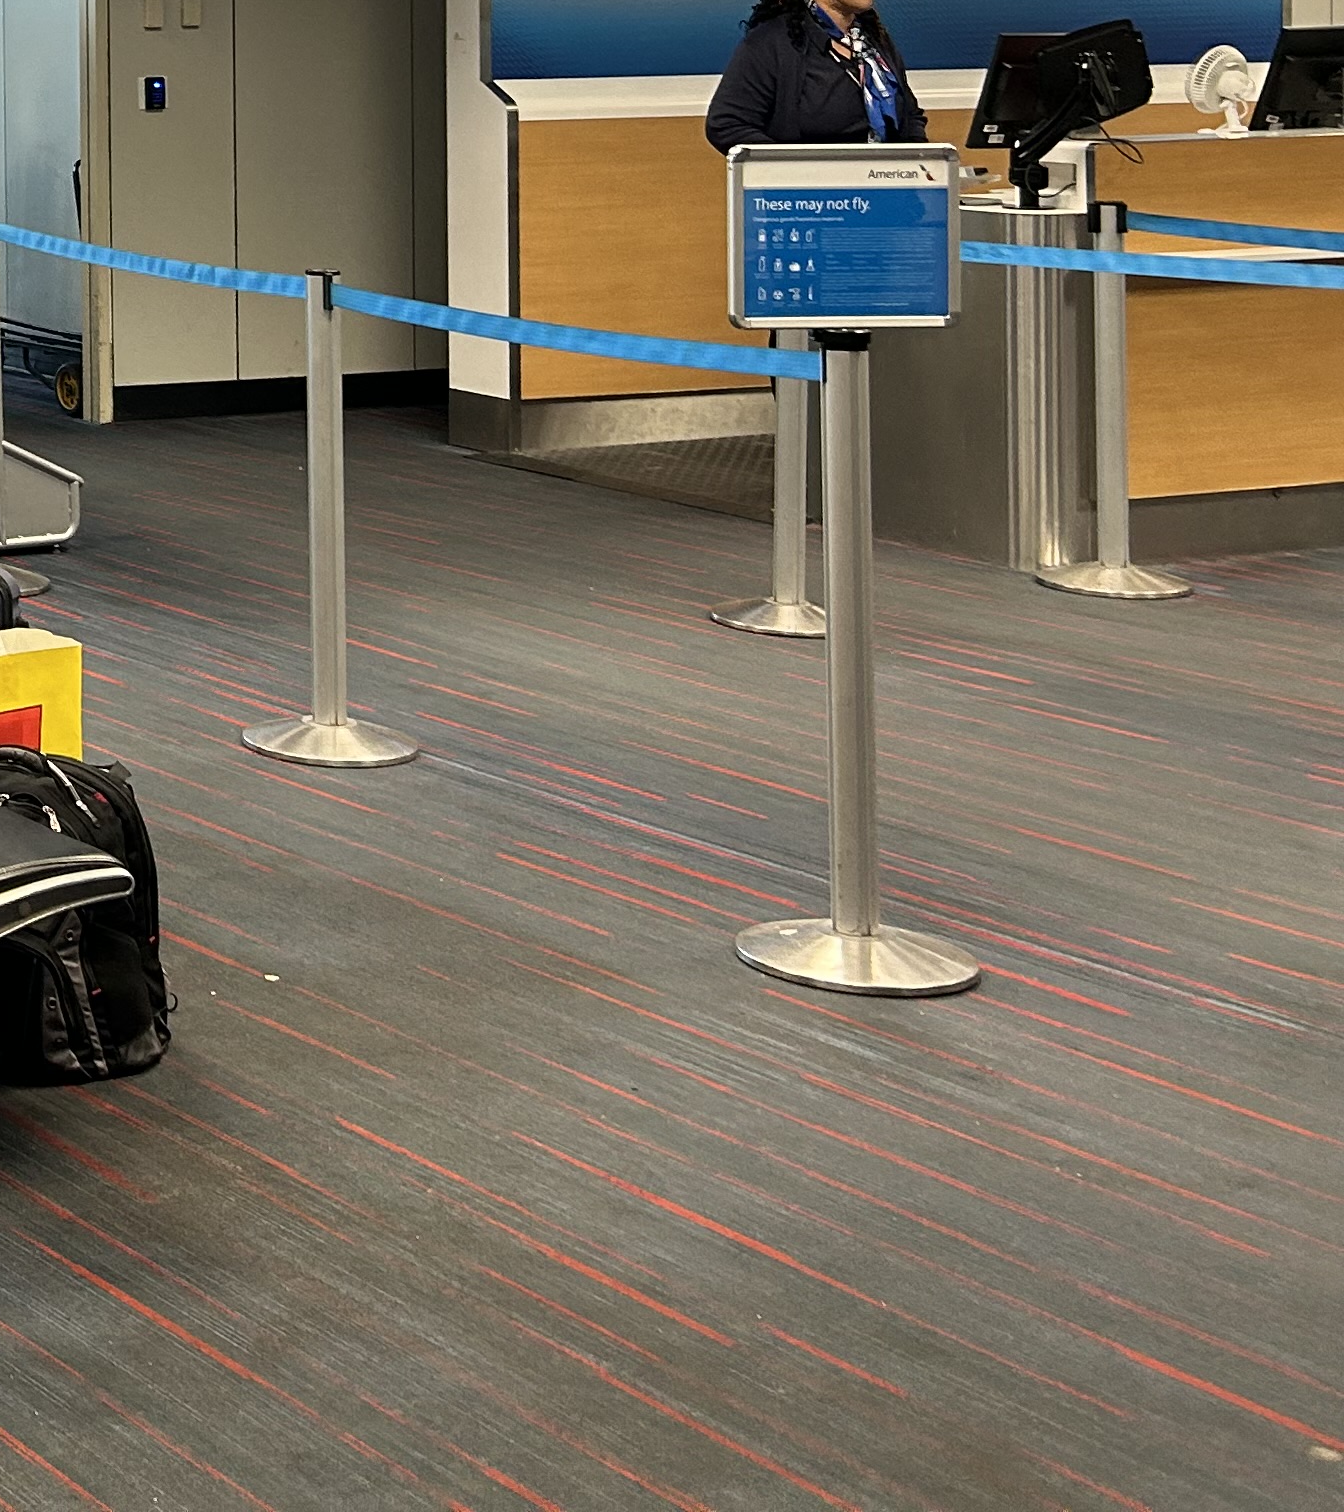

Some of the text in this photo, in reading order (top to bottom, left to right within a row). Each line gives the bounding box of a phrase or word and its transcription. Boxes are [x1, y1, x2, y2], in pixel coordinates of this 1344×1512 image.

[868, 169, 919, 179] American
[753, 196, 871, 214] These may not fly.
